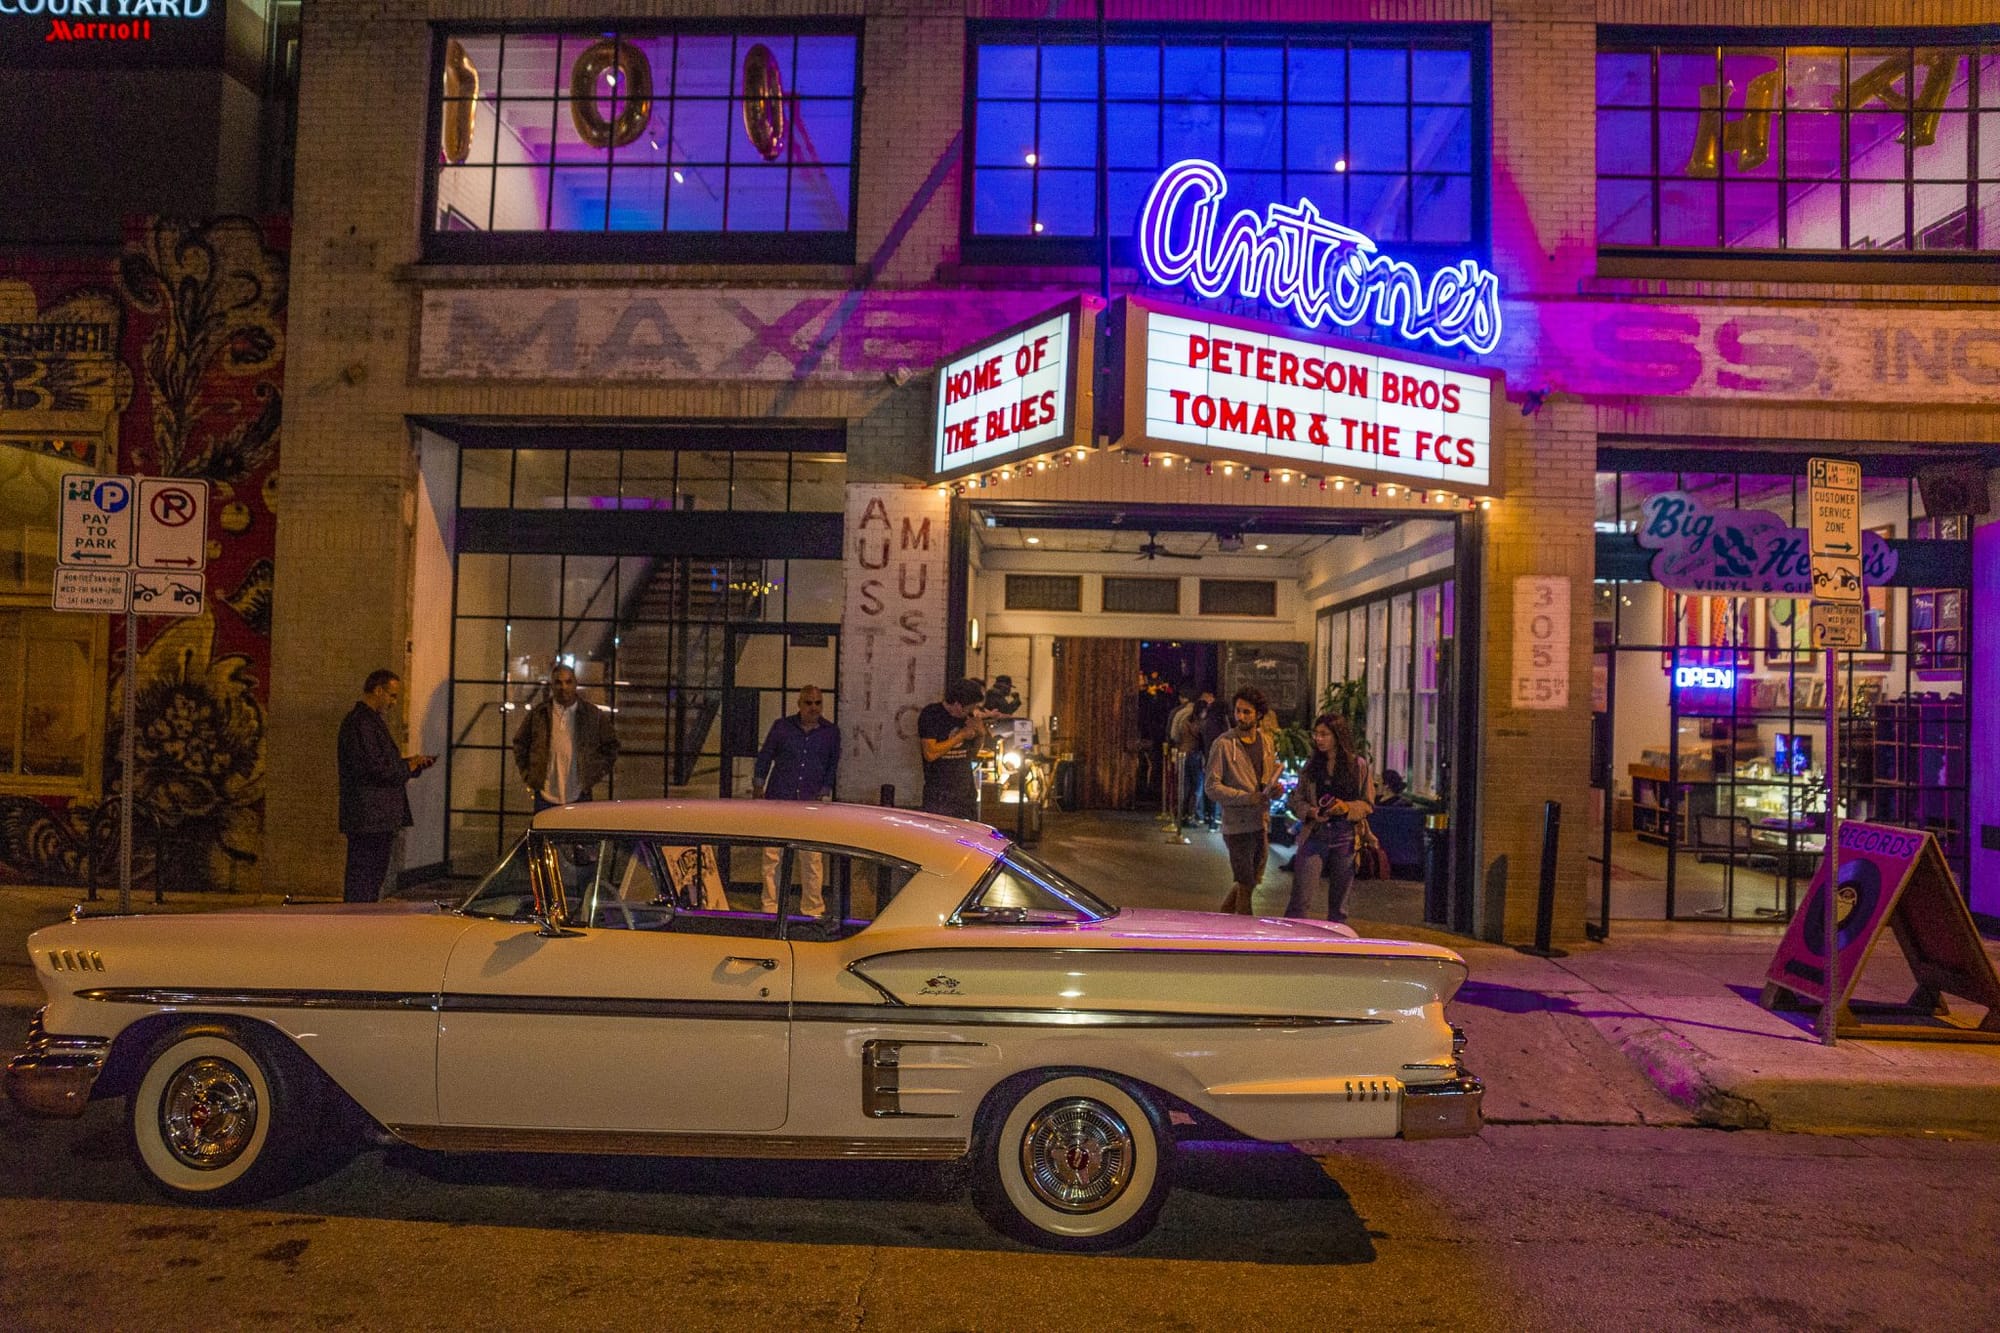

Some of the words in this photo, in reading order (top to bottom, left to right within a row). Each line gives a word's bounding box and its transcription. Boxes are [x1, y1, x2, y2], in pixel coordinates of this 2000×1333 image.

[1140, 158, 1502, 354] Antone's
[945, 355, 1003, 406] HOME
[1015, 336, 1049, 377] OF
[1188, 334, 1369, 399] PETERSON
[1382, 371, 1461, 414] BROS
[944, 416, 979, 455] THE
[986, 389, 1056, 443] BLUES
[1169, 389, 1297, 441] TOMAR
[1308, 413, 1330, 447] &
[1340, 417, 1401, 457] THE
[1415, 430, 1476, 468] FCS
[1811, 461, 1826, 478] 15
[1814, 491, 1855, 504] CUSTOMER
[82, 514, 110, 525] PAY
[1819, 506, 1852, 519] SERVICE
[88, 526, 107, 536] TO
[1649, 496, 1714, 552] Big
[1825, 521, 1845, 533] ZONE
[75, 537, 117, 549] PARK
[1694, 580, 1750, 592] VINYL
[1762, 581, 1773, 592] &
[852, 497, 892, 758] AUSTIN
[1676, 667, 1734, 688] OPEN
[1838, 827, 1918, 858] RECORDS
